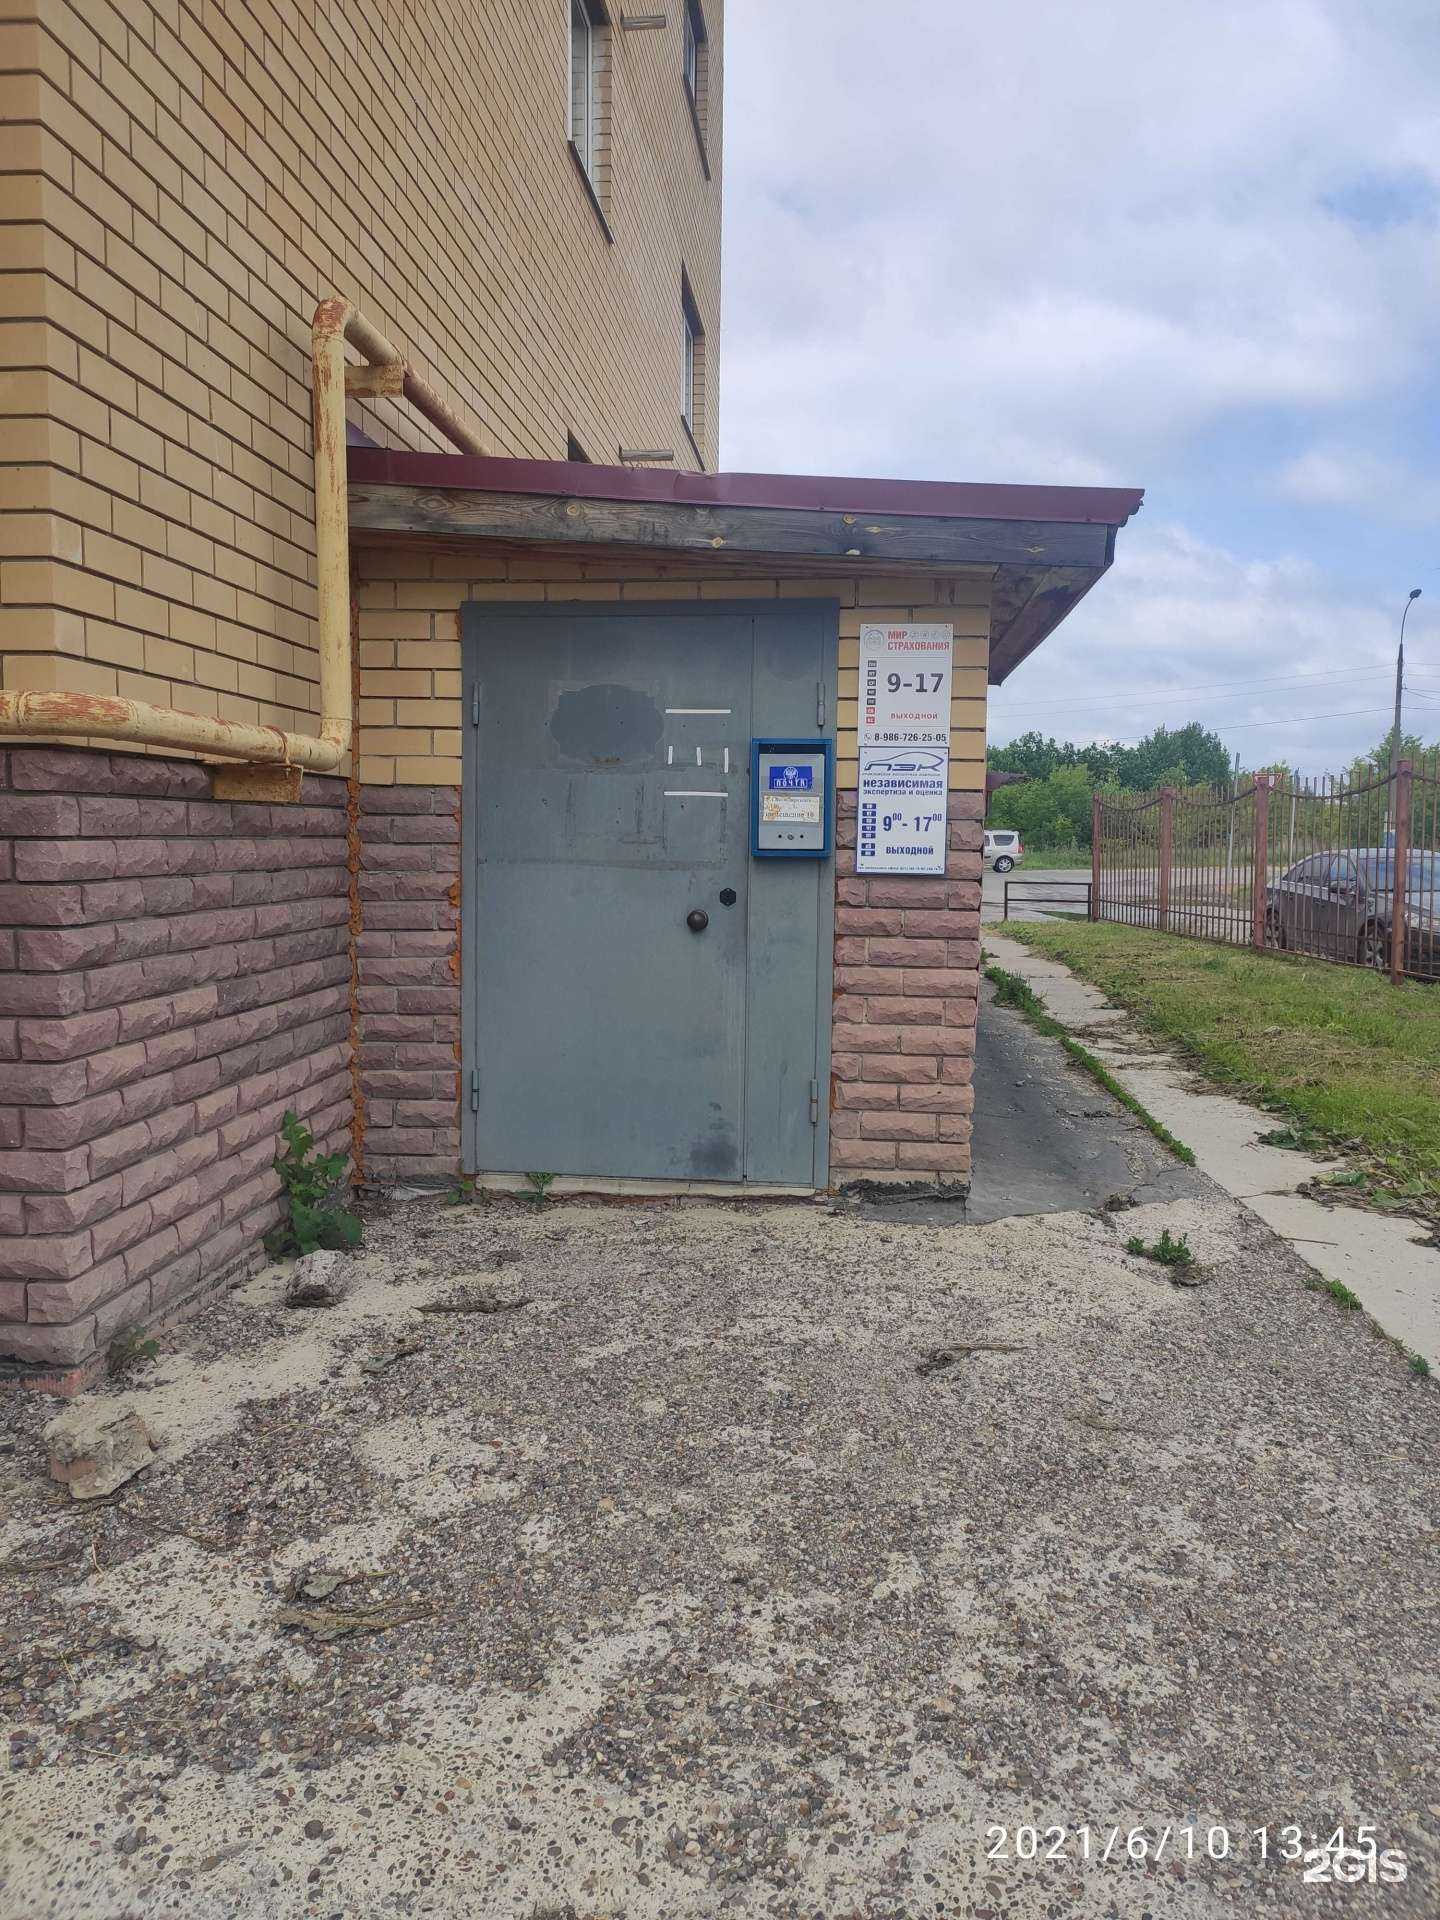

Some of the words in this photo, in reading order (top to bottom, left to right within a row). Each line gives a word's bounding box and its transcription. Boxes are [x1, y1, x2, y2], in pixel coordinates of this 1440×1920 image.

[887, 630, 908, 640] МИР
[887, 641, 950, 651] СТРАХОВАНИЯ
[887, 672, 944, 693] 9-17
[863, 779, 943, 789] независимая
[863, 789, 906, 798] экспертиза
[915, 789, 943, 798] оценка
